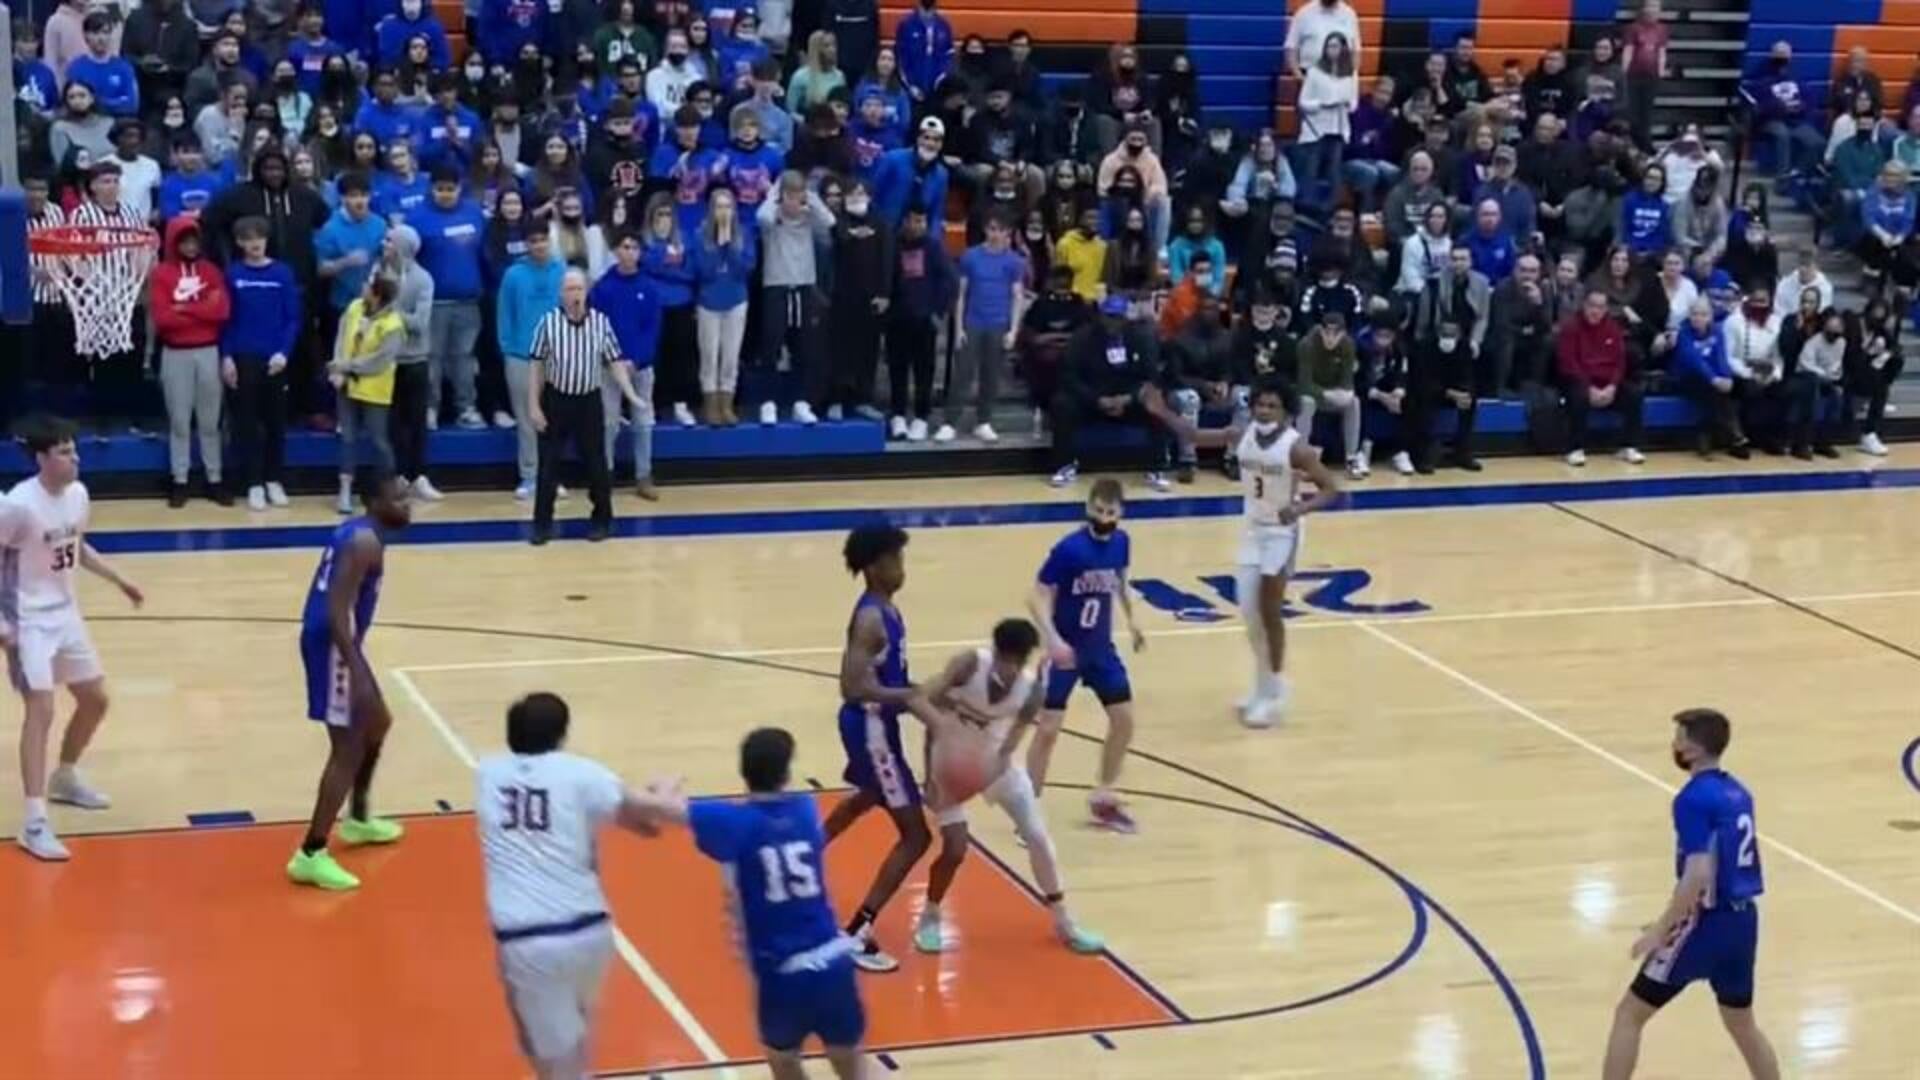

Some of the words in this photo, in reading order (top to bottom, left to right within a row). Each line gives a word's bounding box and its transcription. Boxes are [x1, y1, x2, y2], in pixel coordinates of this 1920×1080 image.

[1253, 476, 1264, 499] 3
[51, 542, 76, 571] 35
[1080, 598, 1101, 628] 0
[499, 785, 549, 832] 30
[759, 840, 821, 902] 15
